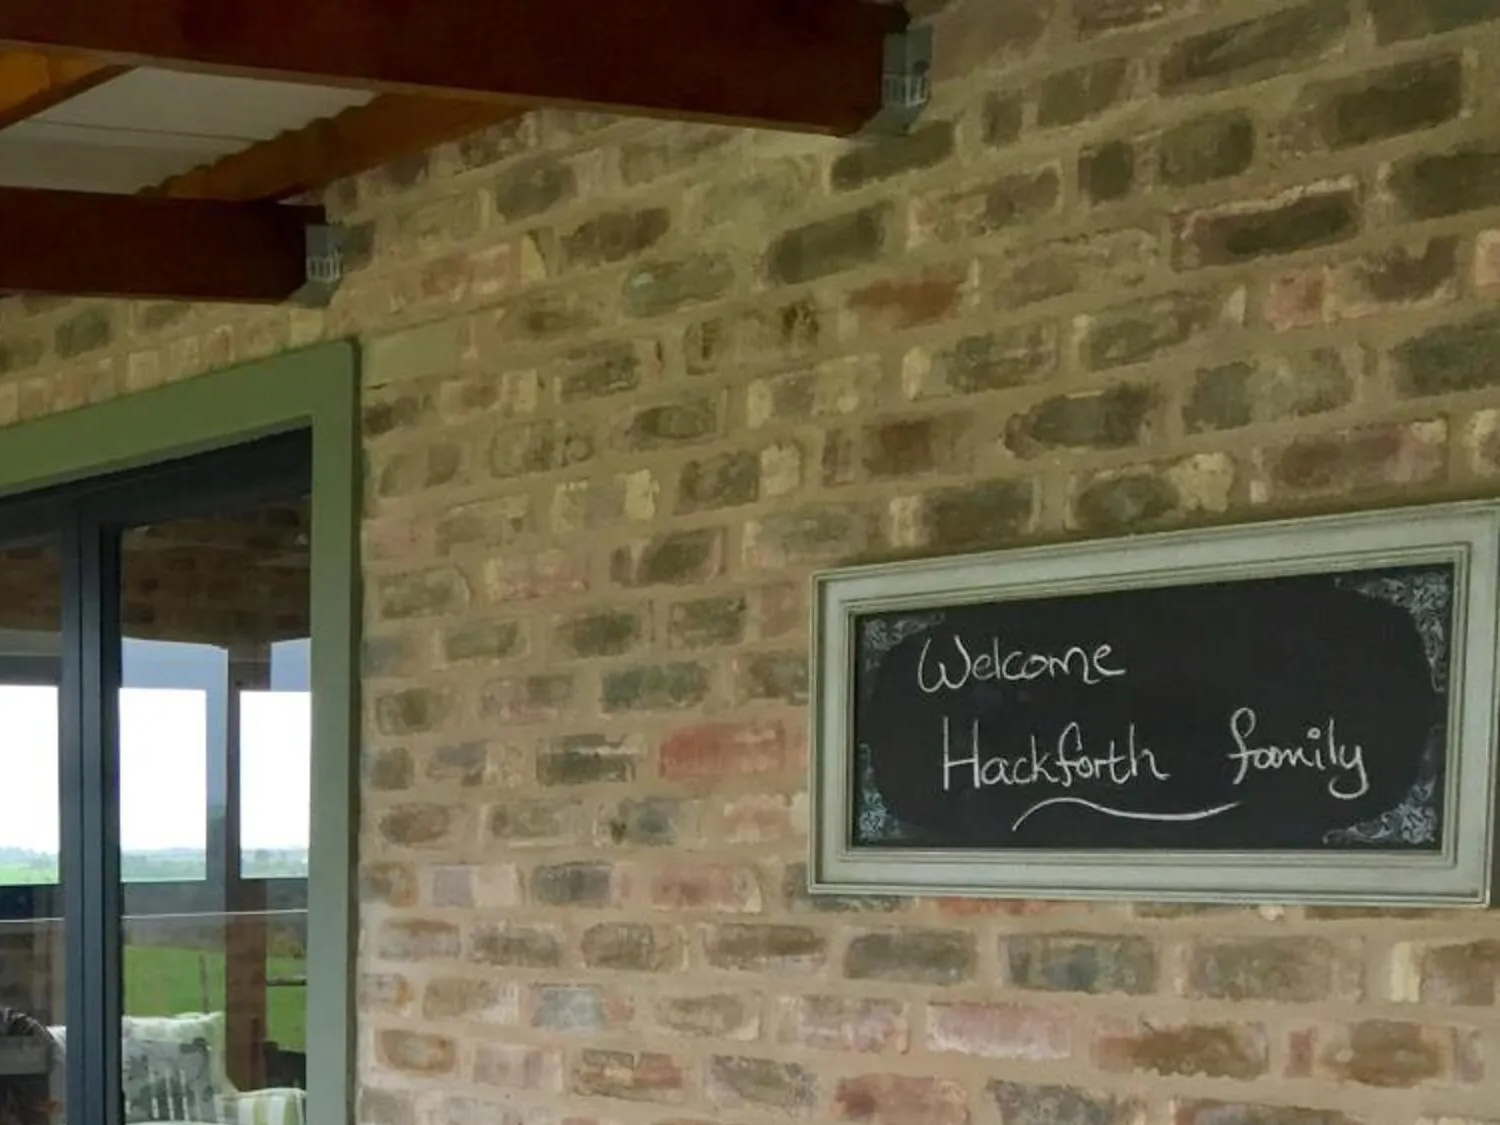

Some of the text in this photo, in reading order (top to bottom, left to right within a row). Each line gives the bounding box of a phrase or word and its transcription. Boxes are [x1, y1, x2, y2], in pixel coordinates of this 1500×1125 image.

[918, 635, 1126, 693] Welcome
[942, 706, 1370, 800] Hackforth family
